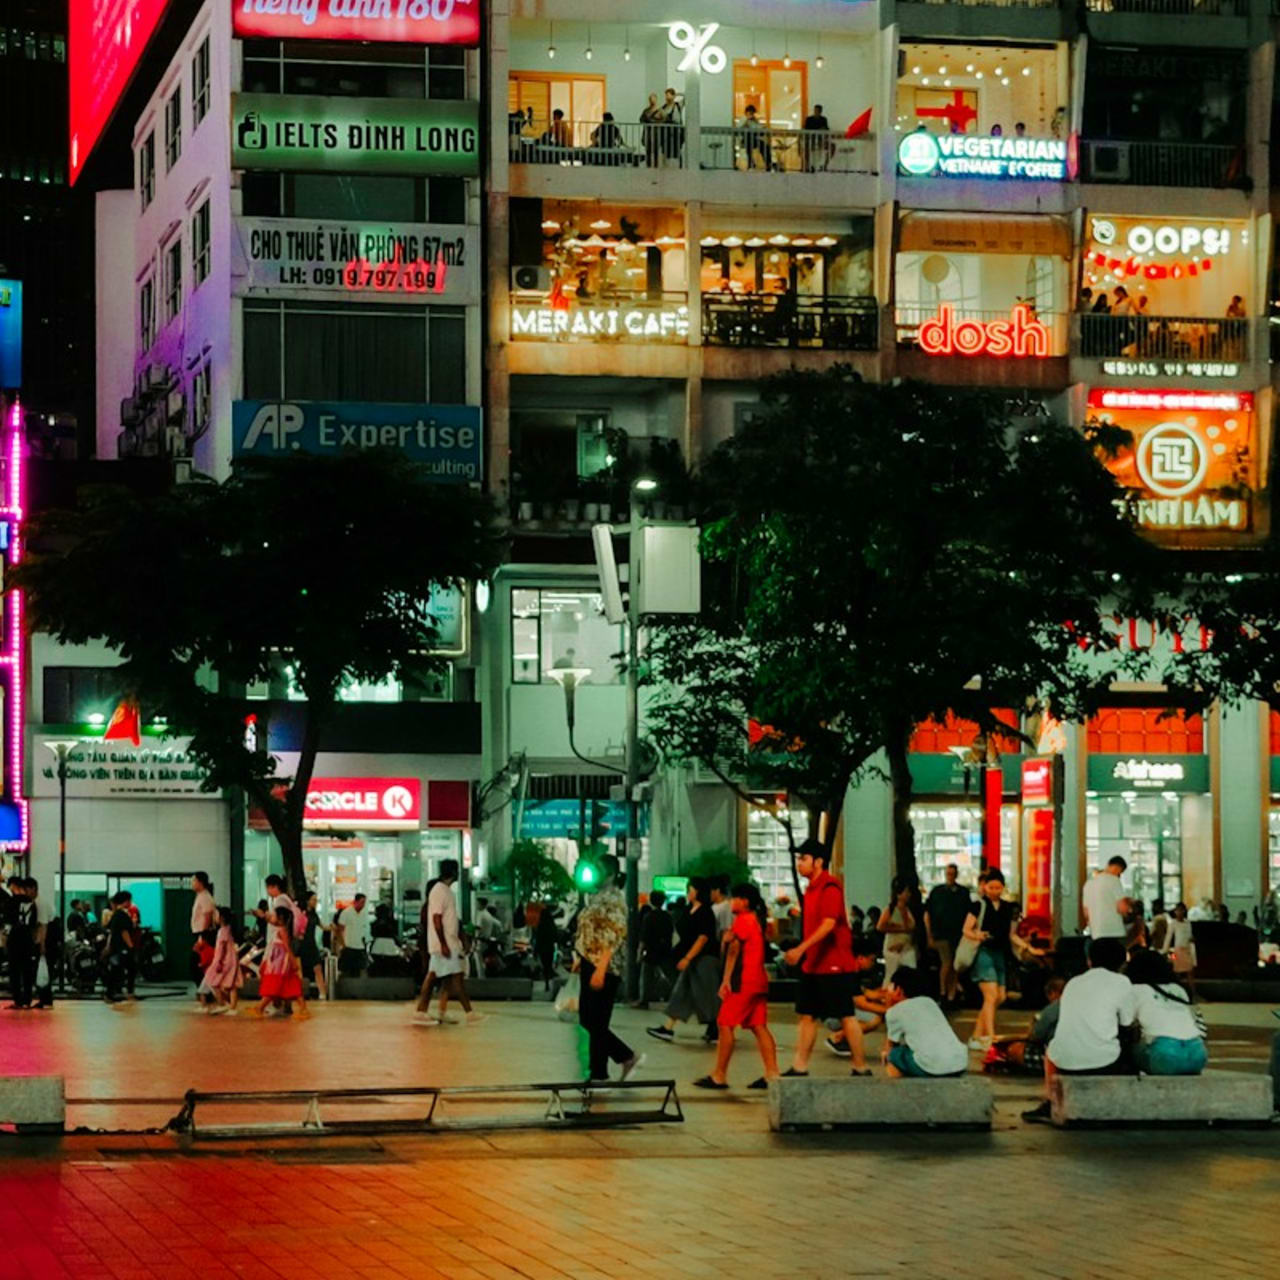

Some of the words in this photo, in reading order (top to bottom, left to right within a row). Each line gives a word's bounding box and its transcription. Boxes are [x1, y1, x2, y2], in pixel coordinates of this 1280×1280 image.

[275, 122, 338, 150] IELTS
[348, 120, 405, 151] ĐÌNH
[415, 126, 475, 152] LONG
[937, 136, 1066, 161] VEGETARIAN
[250, 229, 282, 261] CHO
[286, 226, 325, 261] THUÊ
[329, 227, 360, 262] VĂN
[364, 228, 418, 265] PHÒNG
[423, 236, 465, 267] 67m2
[1127, 226, 1231, 255] OOPS!
[279, 267, 307, 284] LH:
[312, 268, 436, 289] 0919.797.199
[511, 310, 619, 336] MERAKI
[624, 305, 690, 336] CAFÉ
[919, 302, 1049, 357] dosh
[319, 415, 475, 449] Expertise
[58, 767, 88, 780] ÔNG
